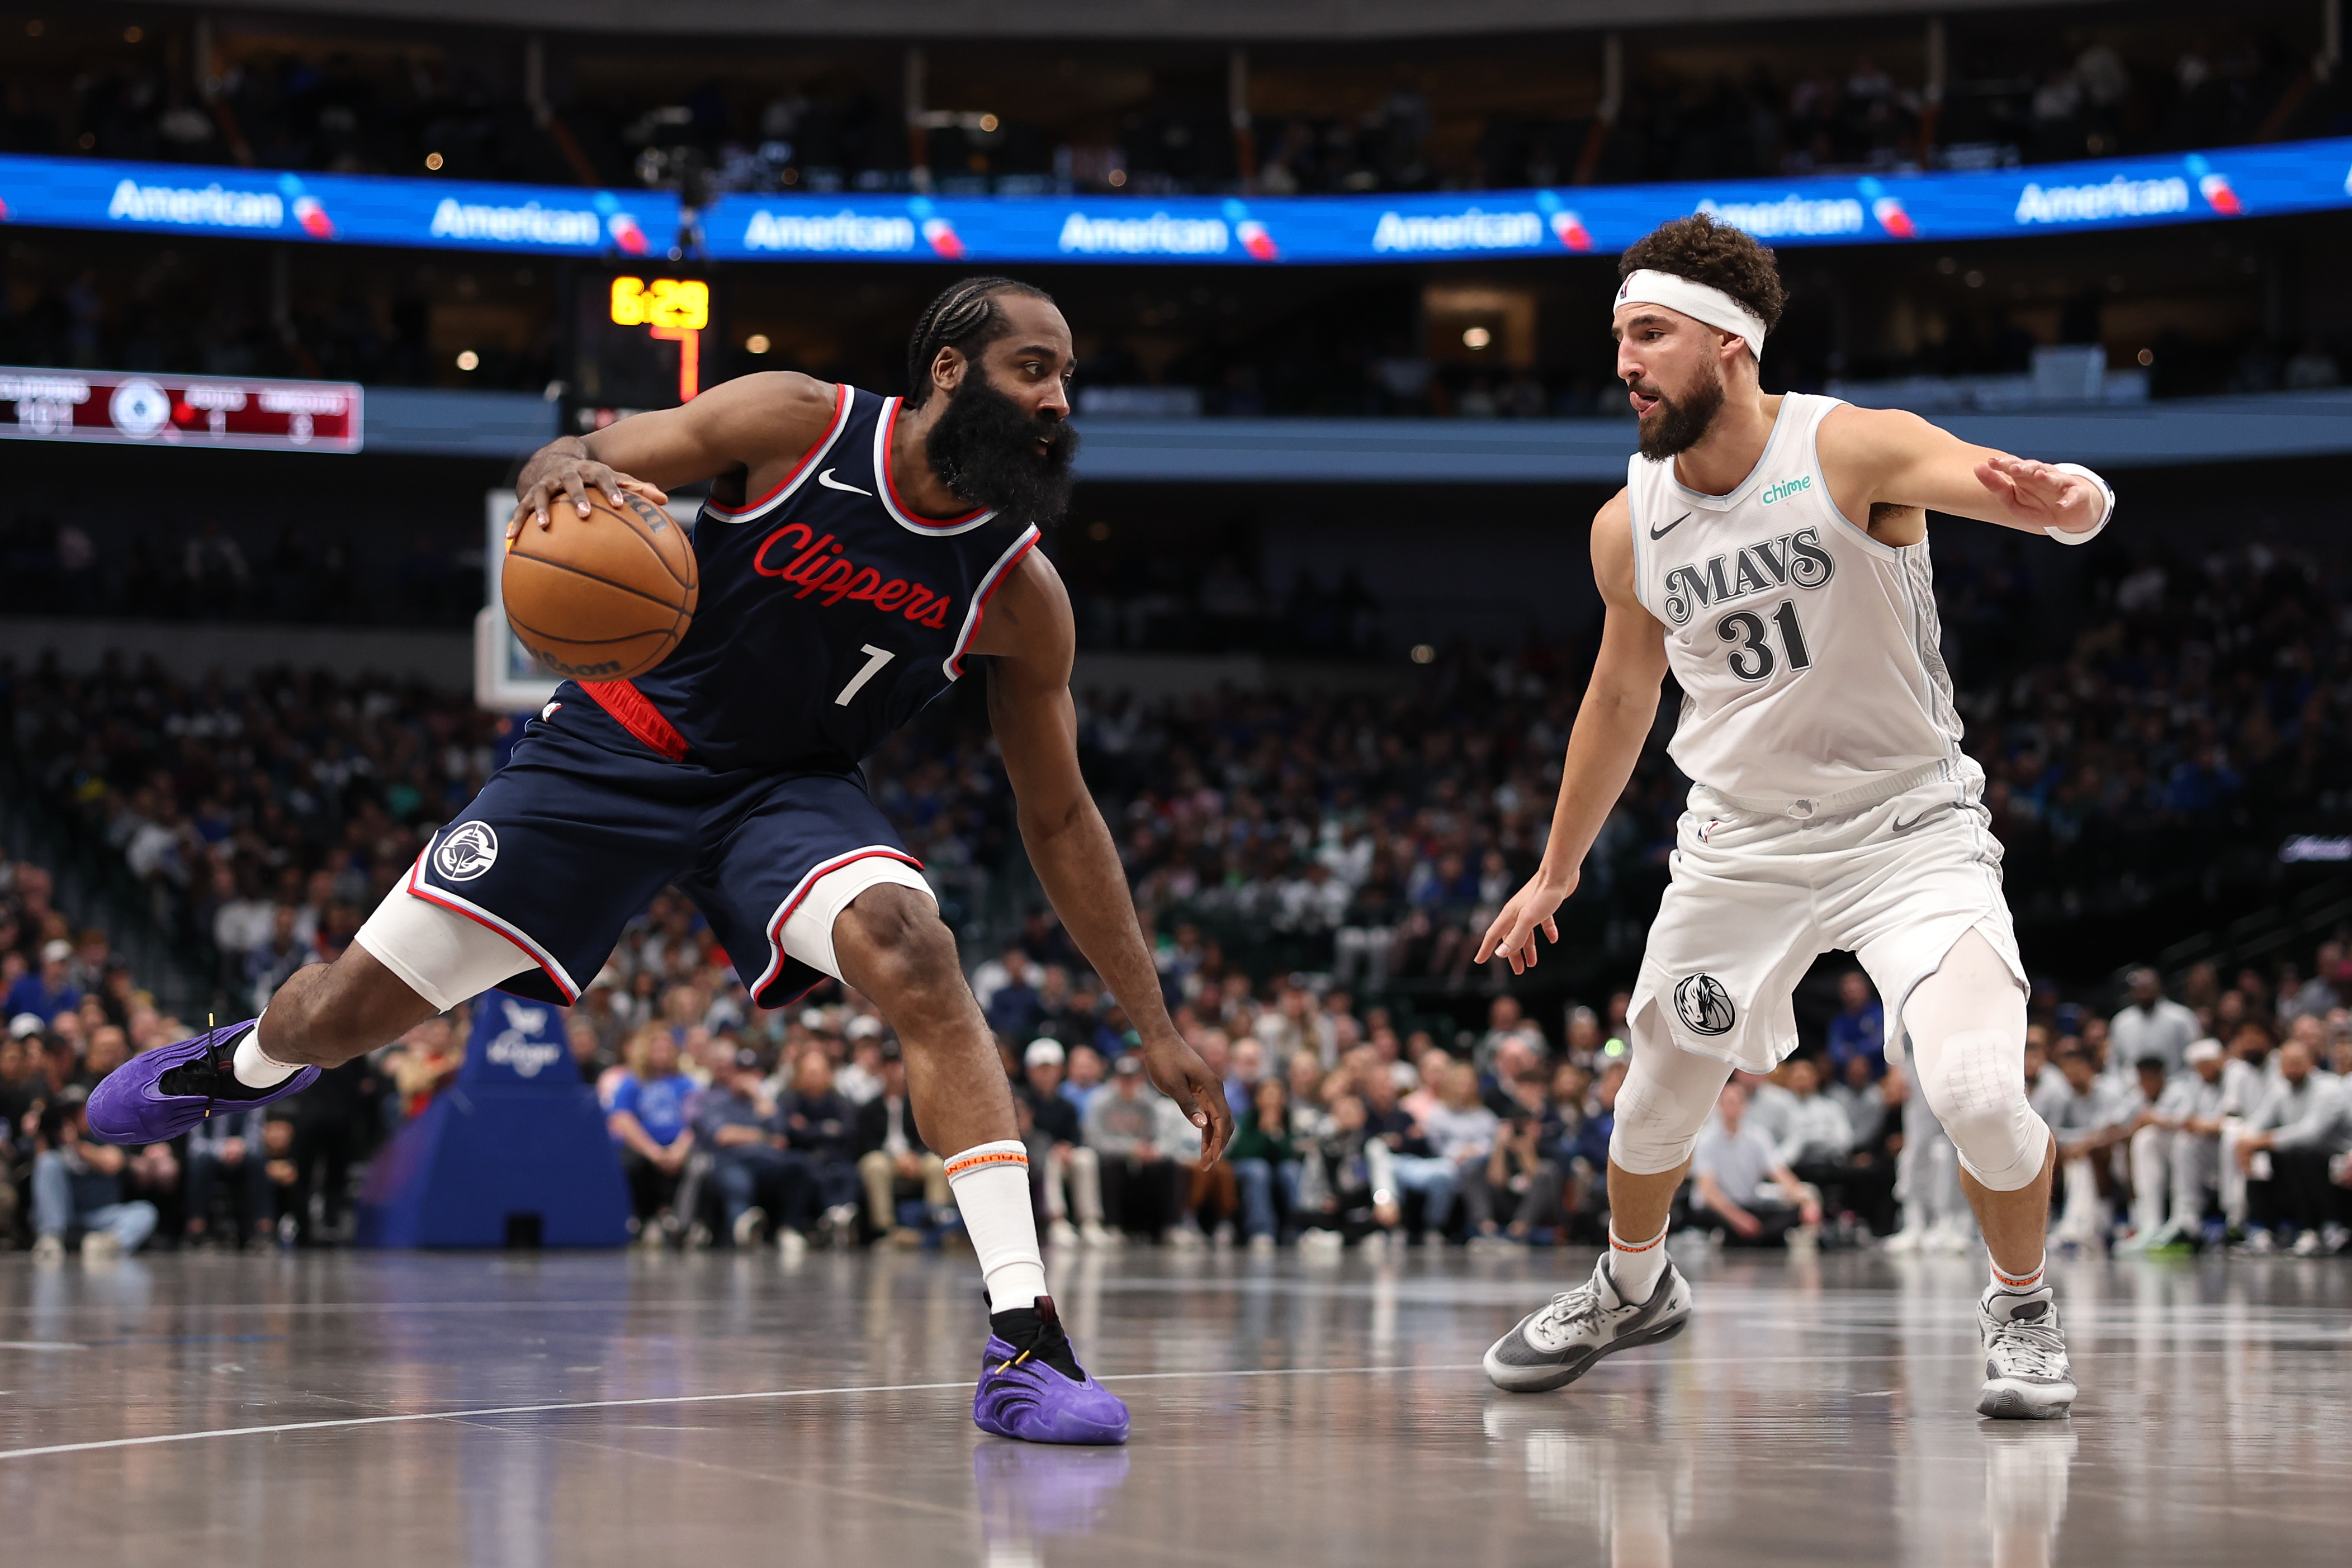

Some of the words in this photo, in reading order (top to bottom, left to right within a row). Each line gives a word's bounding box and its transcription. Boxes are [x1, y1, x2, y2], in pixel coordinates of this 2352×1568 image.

[109, 179, 283, 228] American
[430, 198, 600, 245] American
[2015, 176, 2190, 224] American
[744, 209, 915, 252] American
[1059, 212, 1229, 254] American
[1373, 210, 1542, 252] American
[611, 277, 709, 330] 6:29
[1763, 475, 1811, 504] chime
[754, 523, 950, 629] Clippers
[1664, 526, 1835, 625] MAVS
[1716, 599, 1812, 683] 31
[835, 643, 896, 706] 1
